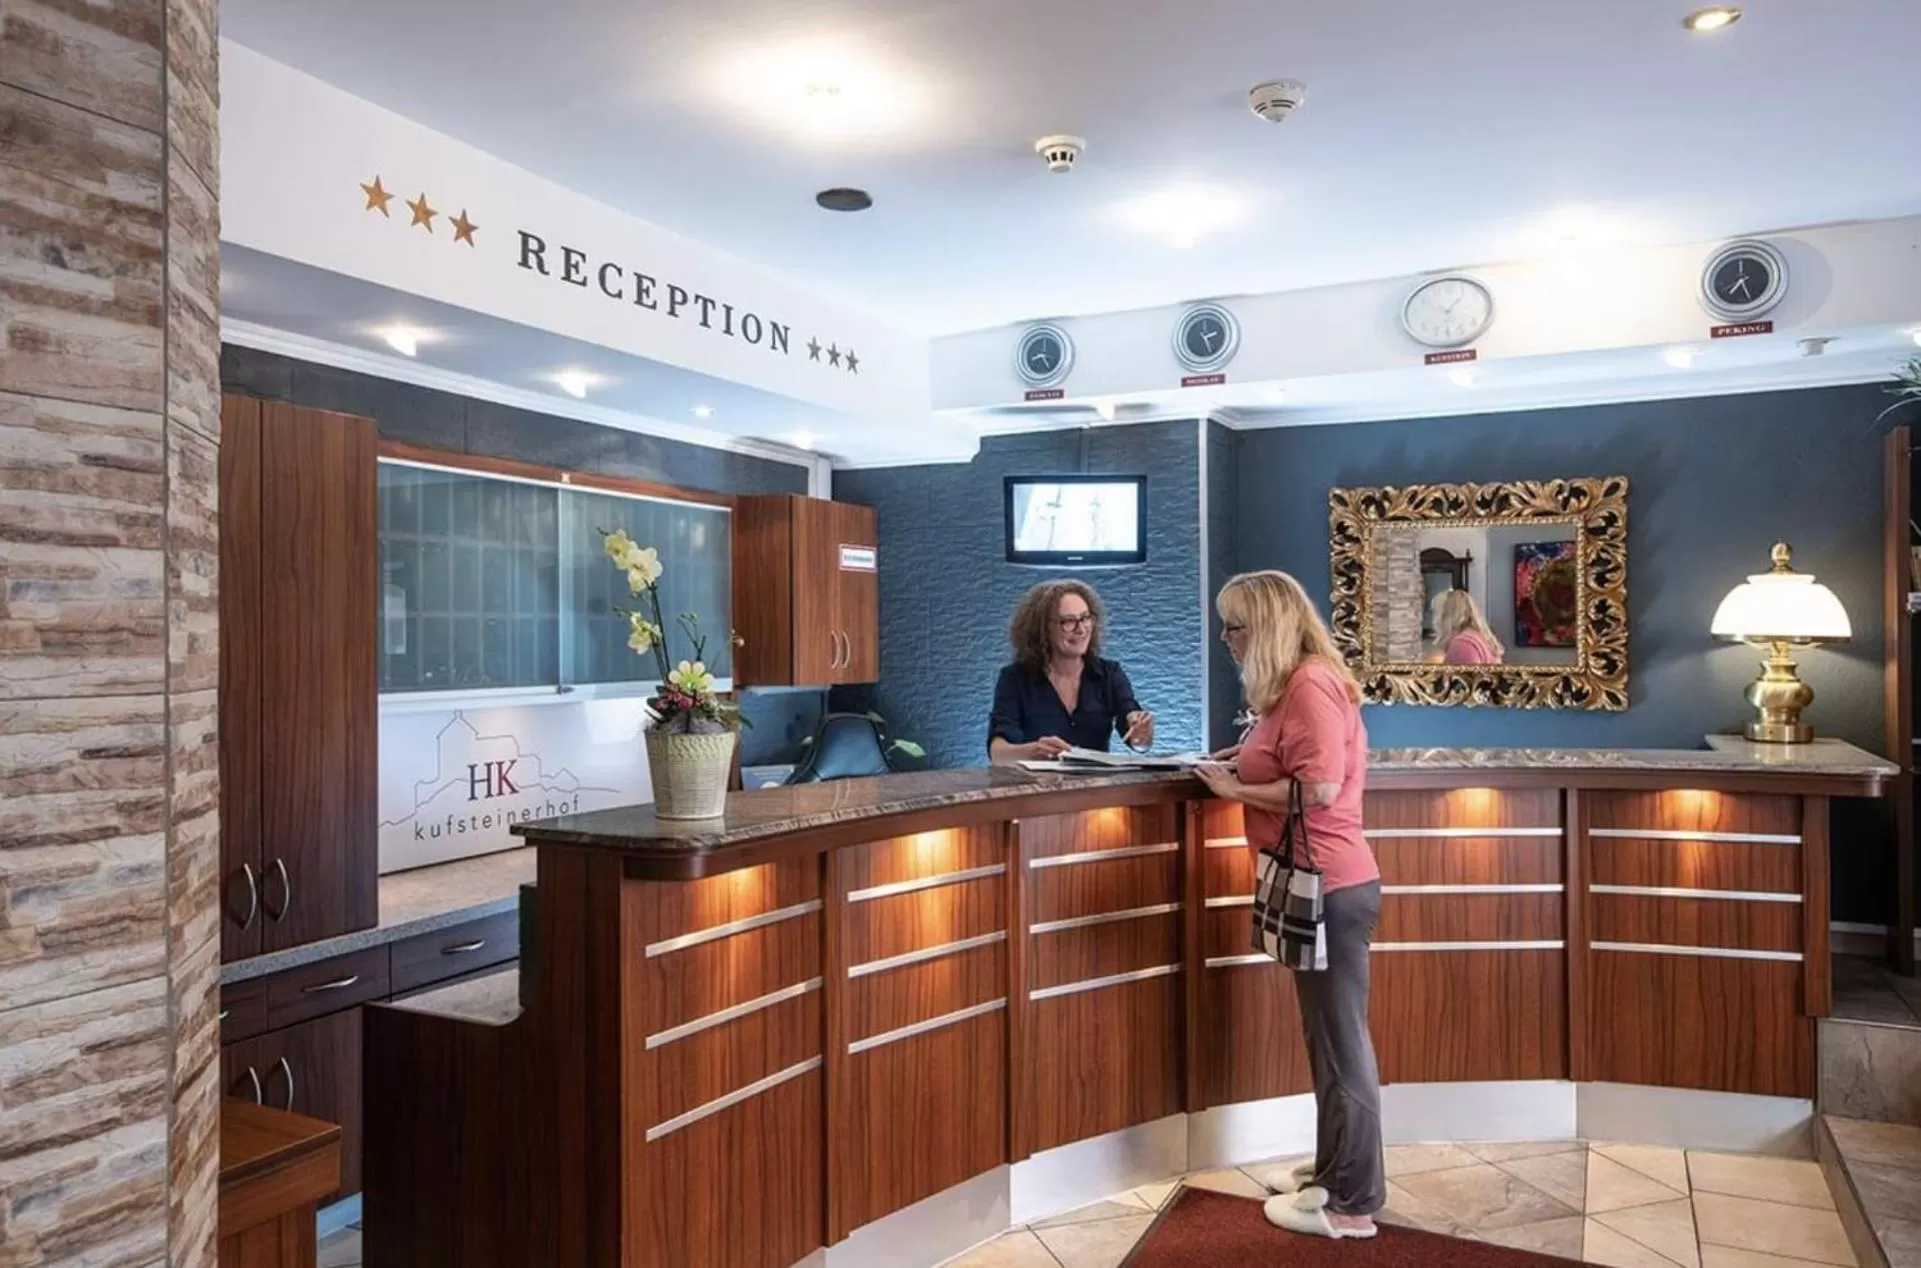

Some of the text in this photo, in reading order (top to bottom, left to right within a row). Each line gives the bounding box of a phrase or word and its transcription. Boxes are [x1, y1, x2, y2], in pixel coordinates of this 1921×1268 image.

[517, 230, 790, 354] RECEPTION
[468, 759, 519, 801] HK
[414, 794, 580, 841] kufsteinerhof
